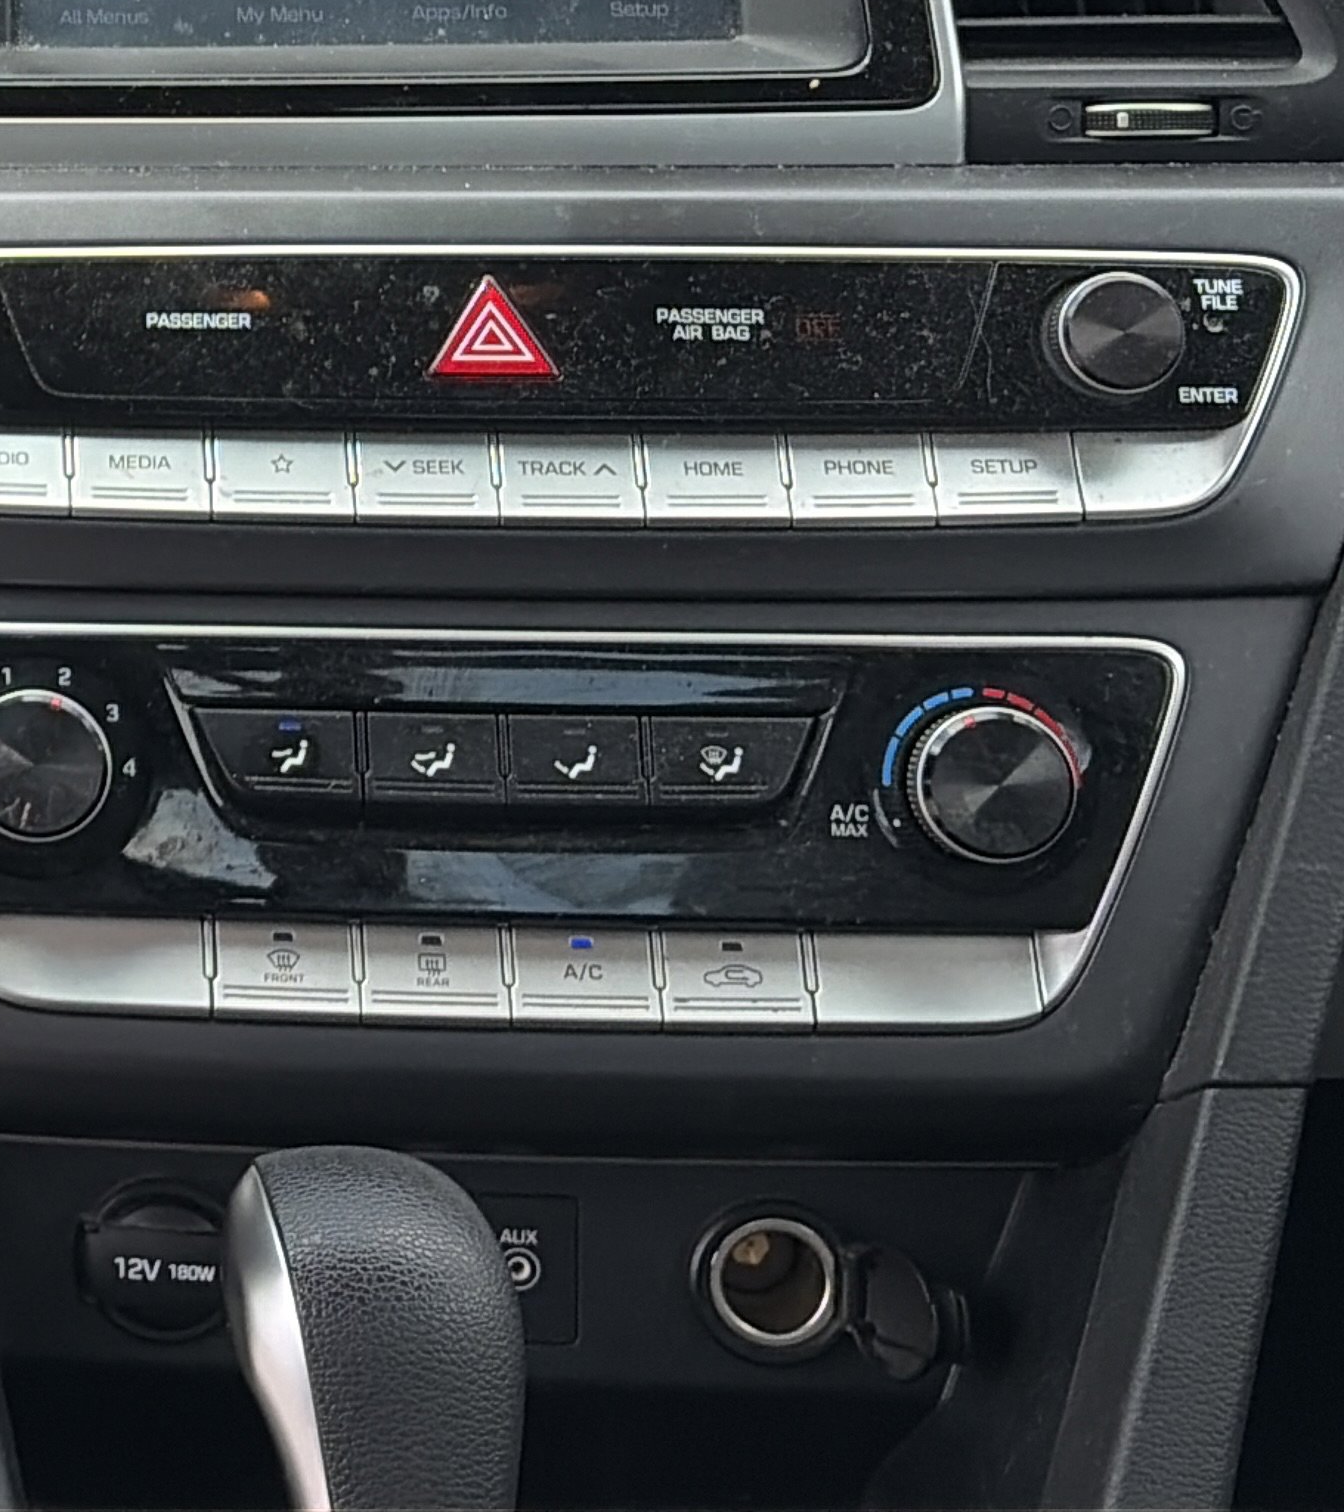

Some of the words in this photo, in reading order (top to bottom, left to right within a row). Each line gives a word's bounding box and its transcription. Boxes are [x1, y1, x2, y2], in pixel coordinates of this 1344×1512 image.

[60, 9, 82, 25] All
[86, 9, 149, 25] Menus
[237, 7, 264, 25] My
[271, 6, 324, 23] Menu
[412, 4, 508, 24] Apps/Info
[610, 1, 668, 19] Setup
[1193, 279, 1244, 294] TUNE
[1201, 296, 1238, 310] FILE
[146, 312, 252, 330] PASSENGER
[656, 308, 764, 324] PASSENGER
[673, 326, 703, 340] AIR
[712, 326, 750, 340] BAG
[1178, 387, 1238, 404] ENTER
[107, 454, 172, 472] MEDIA
[412, 458, 465, 476] SEEK
[516, 459, 588, 478] TRACK
[683, 460, 744, 478] HOME
[823, 458, 895, 476] PHONE
[970, 457, 1038, 475] SETUP
[1, 666, 13, 686] 1
[57, 667, 72, 687] 2
[106, 703, 120, 723] 3
[121, 757, 137, 778] 4
[829, 804, 871, 823] A/C
[830, 822, 869, 838] MAX
[263, 973, 305, 983] FRONT
[562, 963, 604, 982] A/C
[416, 978, 450, 988] REAR
[500, 1228, 538, 1246] AUX
[114, 1256, 161, 1281] 12V
[169, 1264, 216, 1282] 180W
